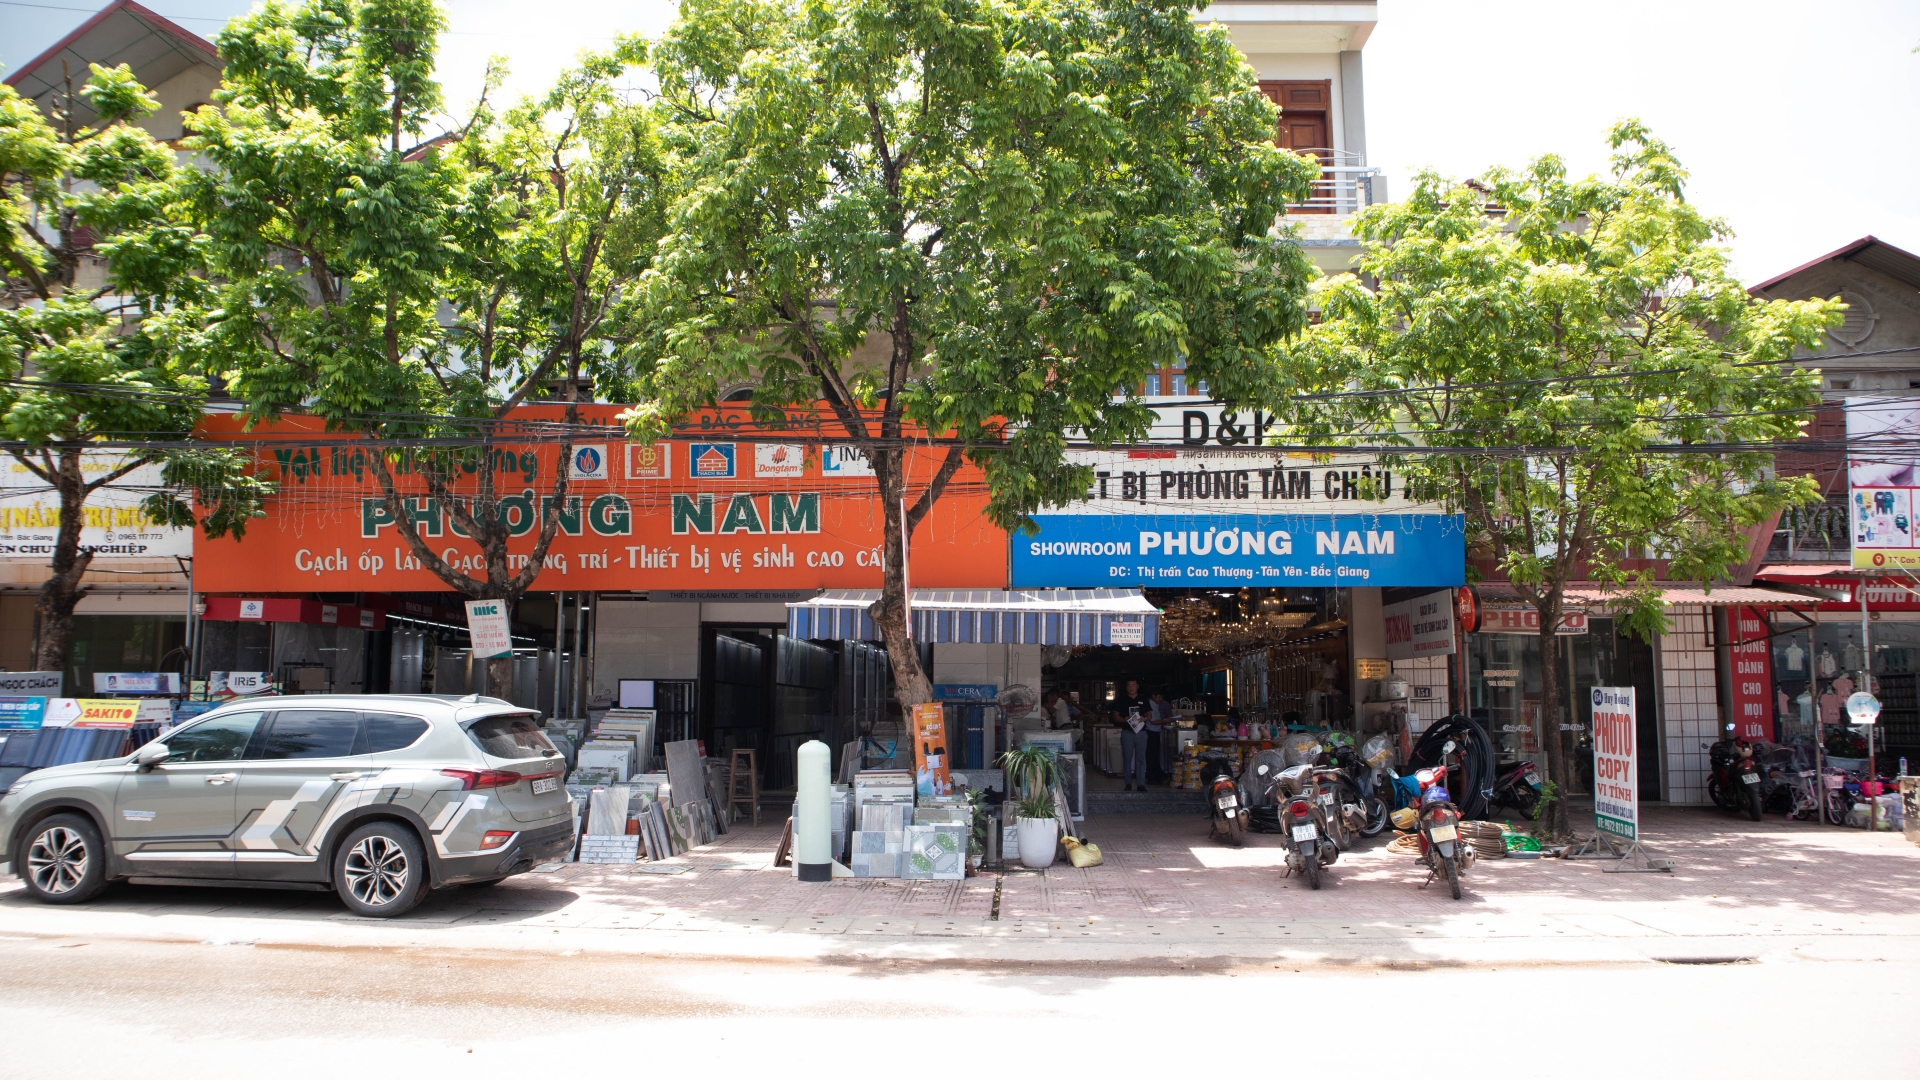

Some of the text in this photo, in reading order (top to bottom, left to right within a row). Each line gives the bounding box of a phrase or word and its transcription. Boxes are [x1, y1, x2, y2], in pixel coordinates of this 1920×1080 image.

[1122, 470, 1147, 505] BỊ
[1160, 463, 1249, 500] PHÒNG
[1261, 460, 1311, 500] TẮM
[671, 491, 821, 536] NAM
[32, 534, 53, 542] Giang
[1030, 527, 1394, 556] SHOWROOM PHƯƠNG NAM
[295, 548, 349, 576] Gạch
[358, 548, 384, 576] ốp
[441, 547, 489, 575] Gạc
[691, 544, 710, 574] bị
[721, 548, 743, 574] vệ
[753, 544, 794, 568] sinh
[806, 550, 844, 568] cao
[1900, 556, 1916, 564] Cao
[1109, 566, 1131, 577] ĐC:
[1137, 565, 1155, 579] Thị
[1158, 565, 1182, 577] trấn
[1187, 566, 1210, 577] Cao
[1212, 566, 1252, 579] Thượng
[1282, 566, 1304, 577] Yên
[1337, 566, 1370, 579] Giang
[1482, 611, 1585, 628] PHOO
[1737, 659, 1764, 674] DÀNH
[1742, 682, 1762, 695] CHO
[1744, 703, 1763, 718] MỌI
[1593, 711, 1632, 757] PHOTO
[1745, 722, 1764, 737] LỨA
[1597, 757, 1630, 783] COPY
[1597, 782, 1632, 802] VI TÍNH
